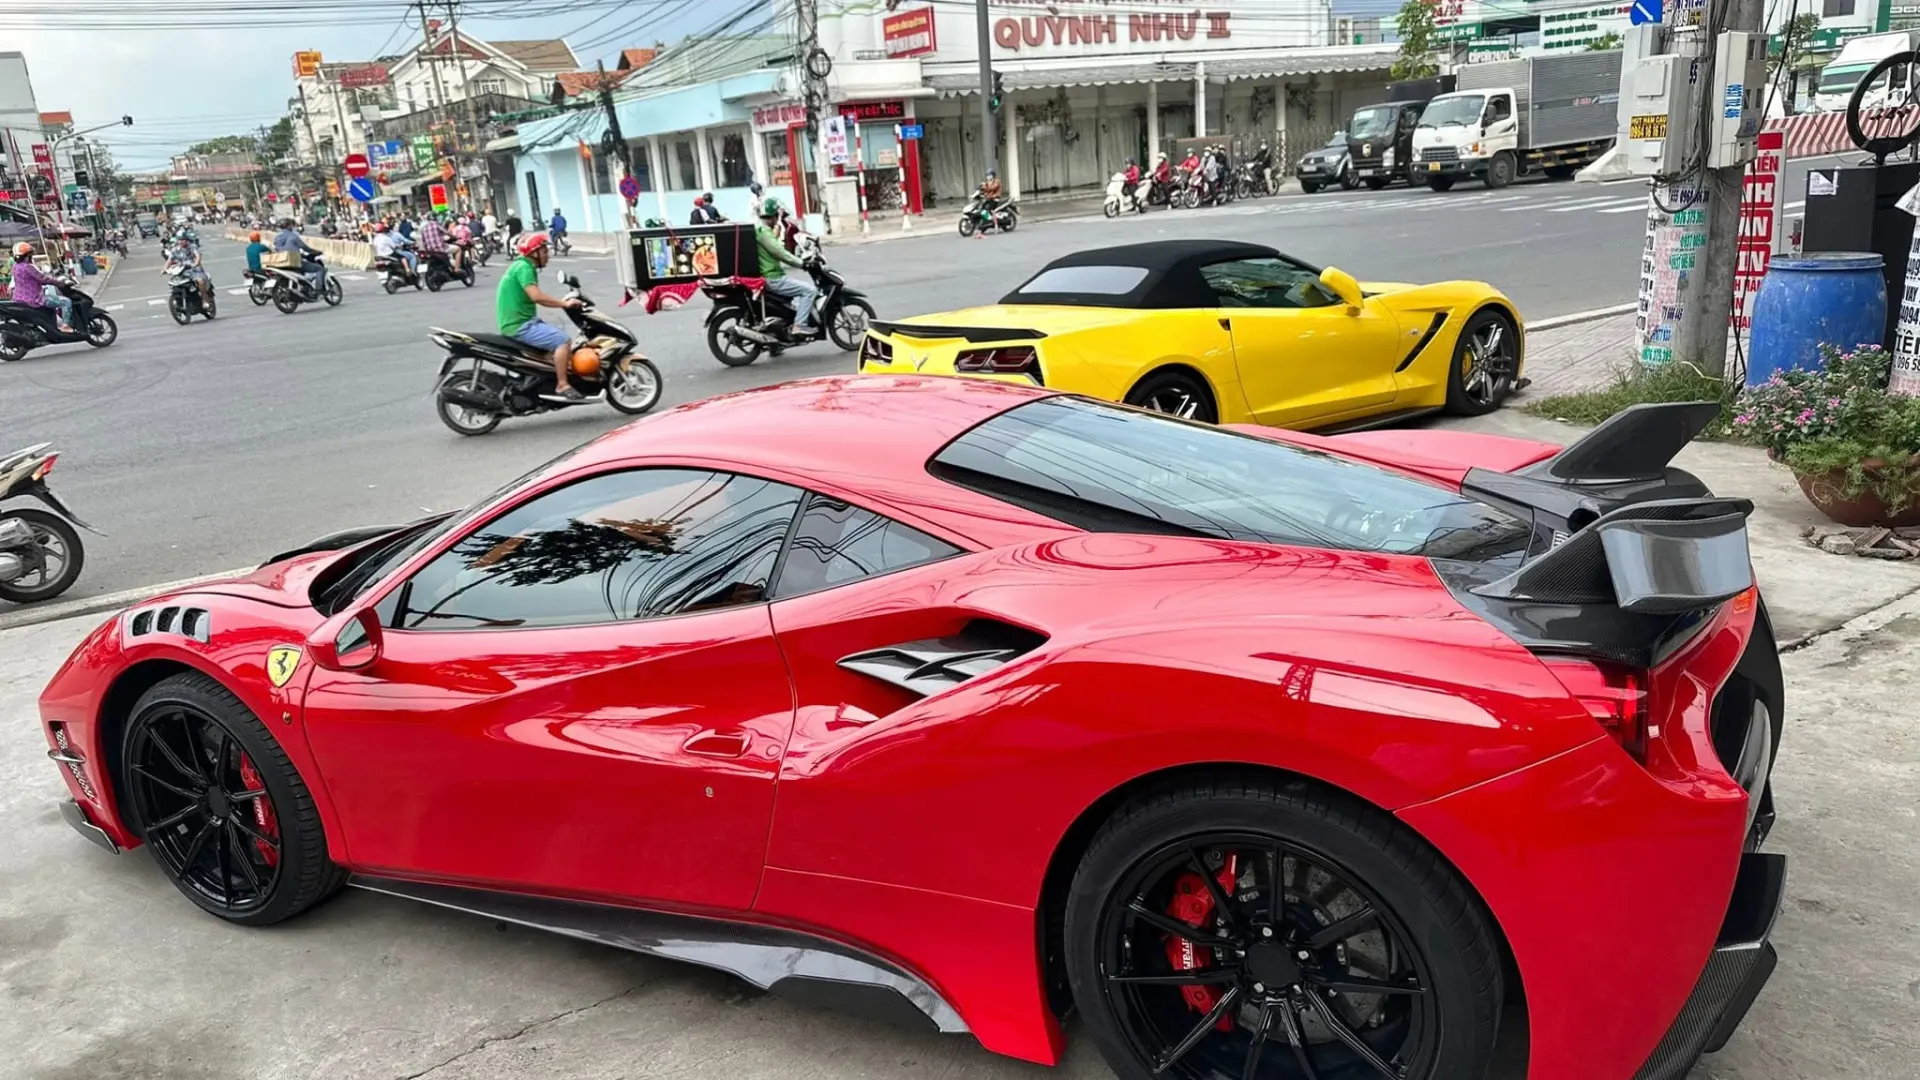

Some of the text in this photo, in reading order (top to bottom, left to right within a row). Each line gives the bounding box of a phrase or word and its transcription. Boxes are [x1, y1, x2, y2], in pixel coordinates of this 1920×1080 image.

[994, 7, 1231, 52] QUỲNH NHƯ II
[1181, 938, 1192, 970] rrar
